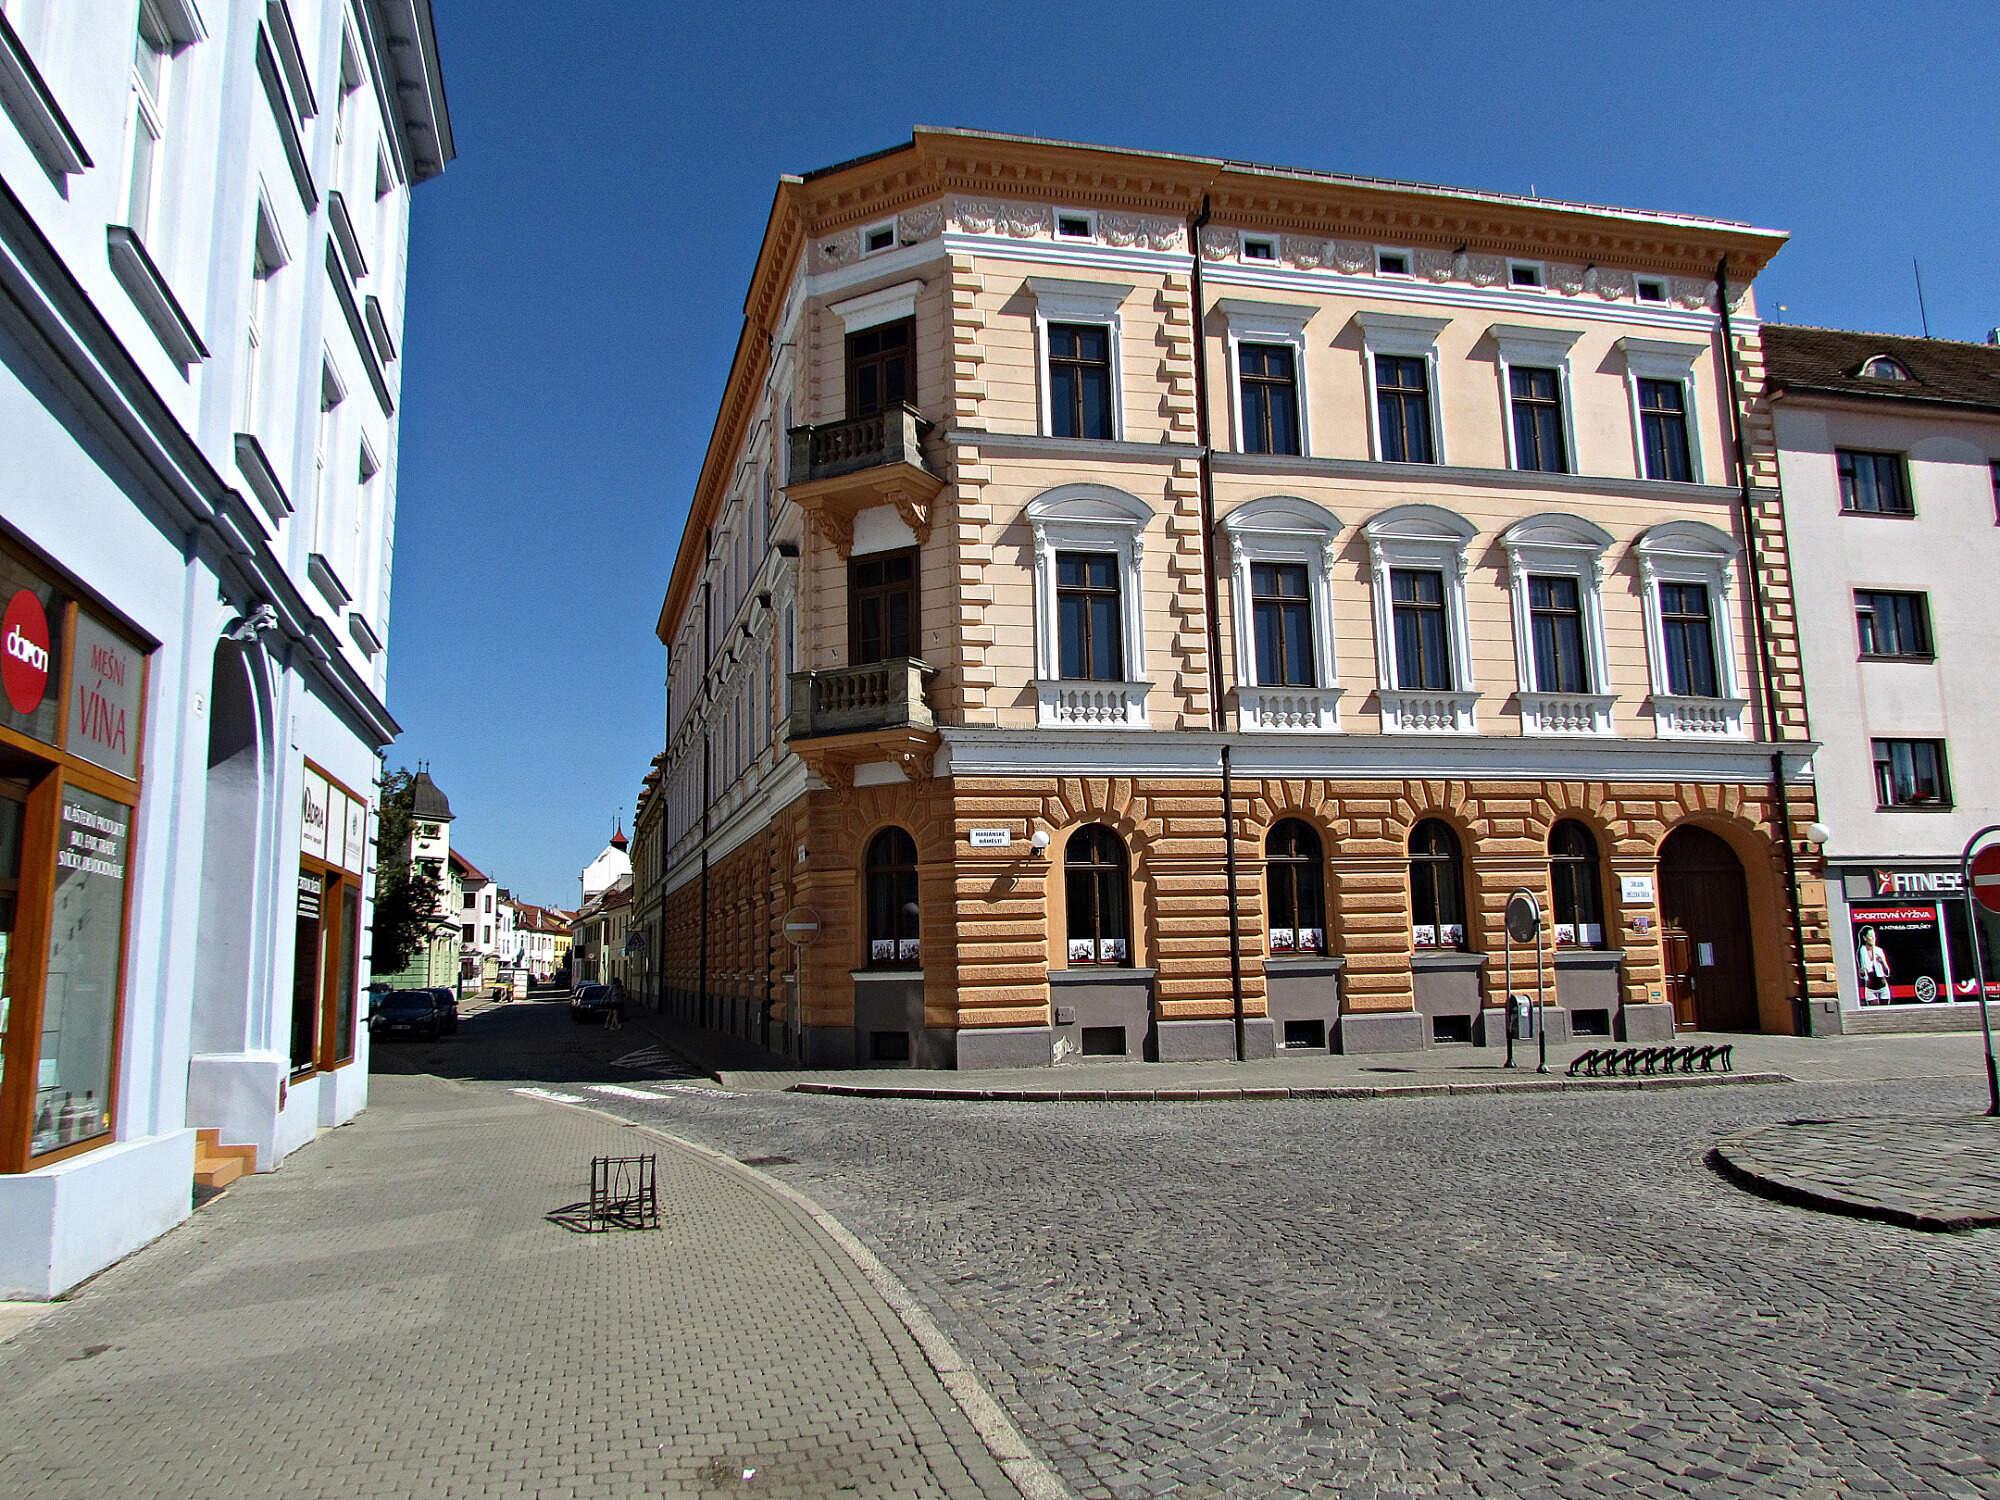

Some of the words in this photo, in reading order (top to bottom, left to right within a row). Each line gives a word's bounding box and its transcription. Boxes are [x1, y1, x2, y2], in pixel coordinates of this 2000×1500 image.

[80, 679, 126, 755] VÍNA
[1854, 910, 1899, 919] SPORTOVNÍ
[1900, 909, 1930, 918] VÝŽIVA
